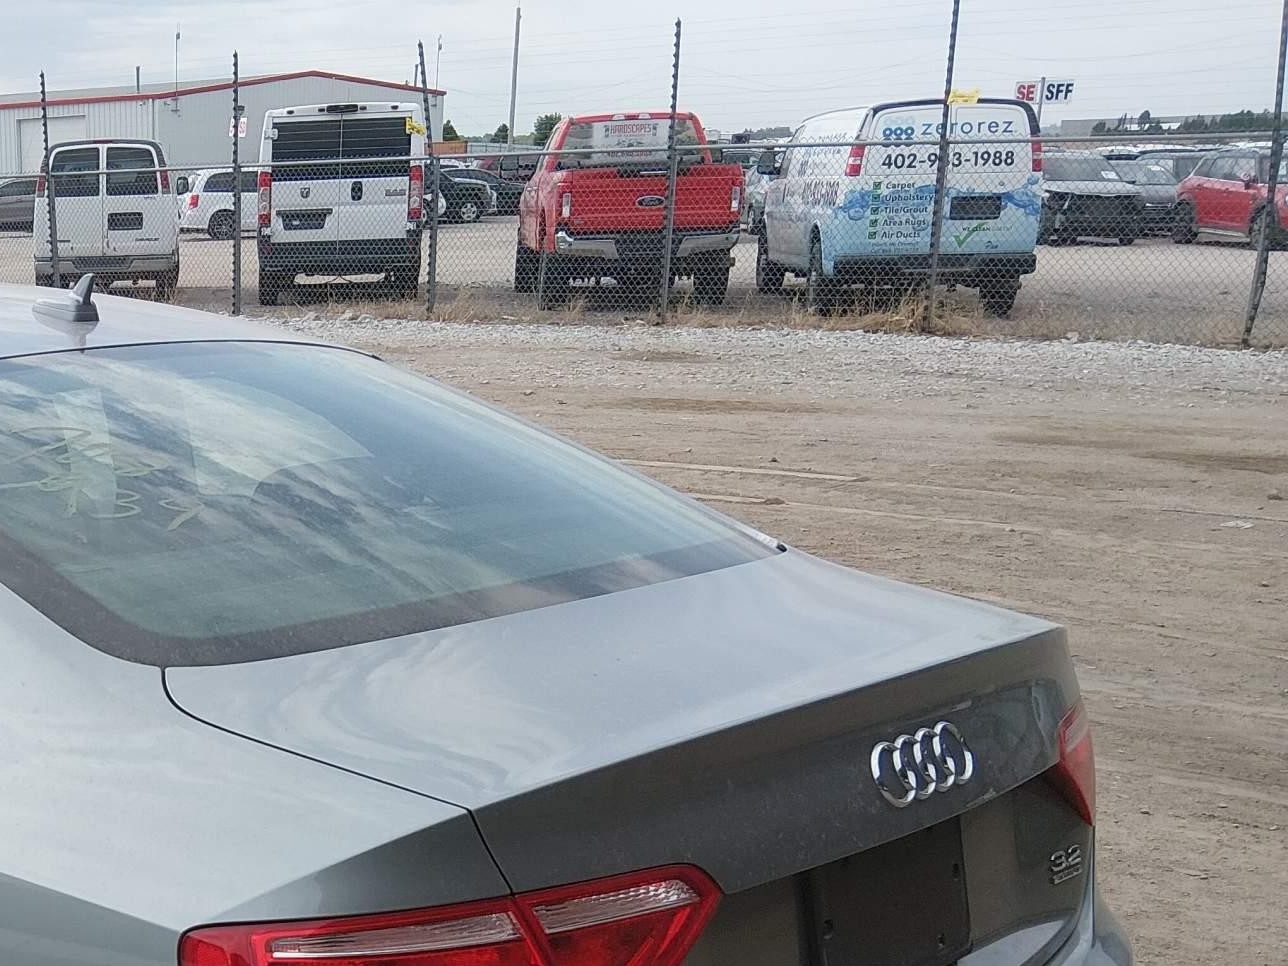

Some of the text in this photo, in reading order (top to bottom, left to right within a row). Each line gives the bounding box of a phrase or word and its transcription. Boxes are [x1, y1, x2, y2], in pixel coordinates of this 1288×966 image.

[1016, 84, 1036, 101] SE
[1045, 83, 1074, 100] SFF
[881, 151, 1015, 169] 402-93-1988
[885, 182, 916, 192] Carpet
[884, 193, 935, 205] Upholstery
[884, 206, 929, 215] Tile/Grout
[882, 217, 927, 228] Area Rugs
[881, 229, 921, 240] Air Ducts
